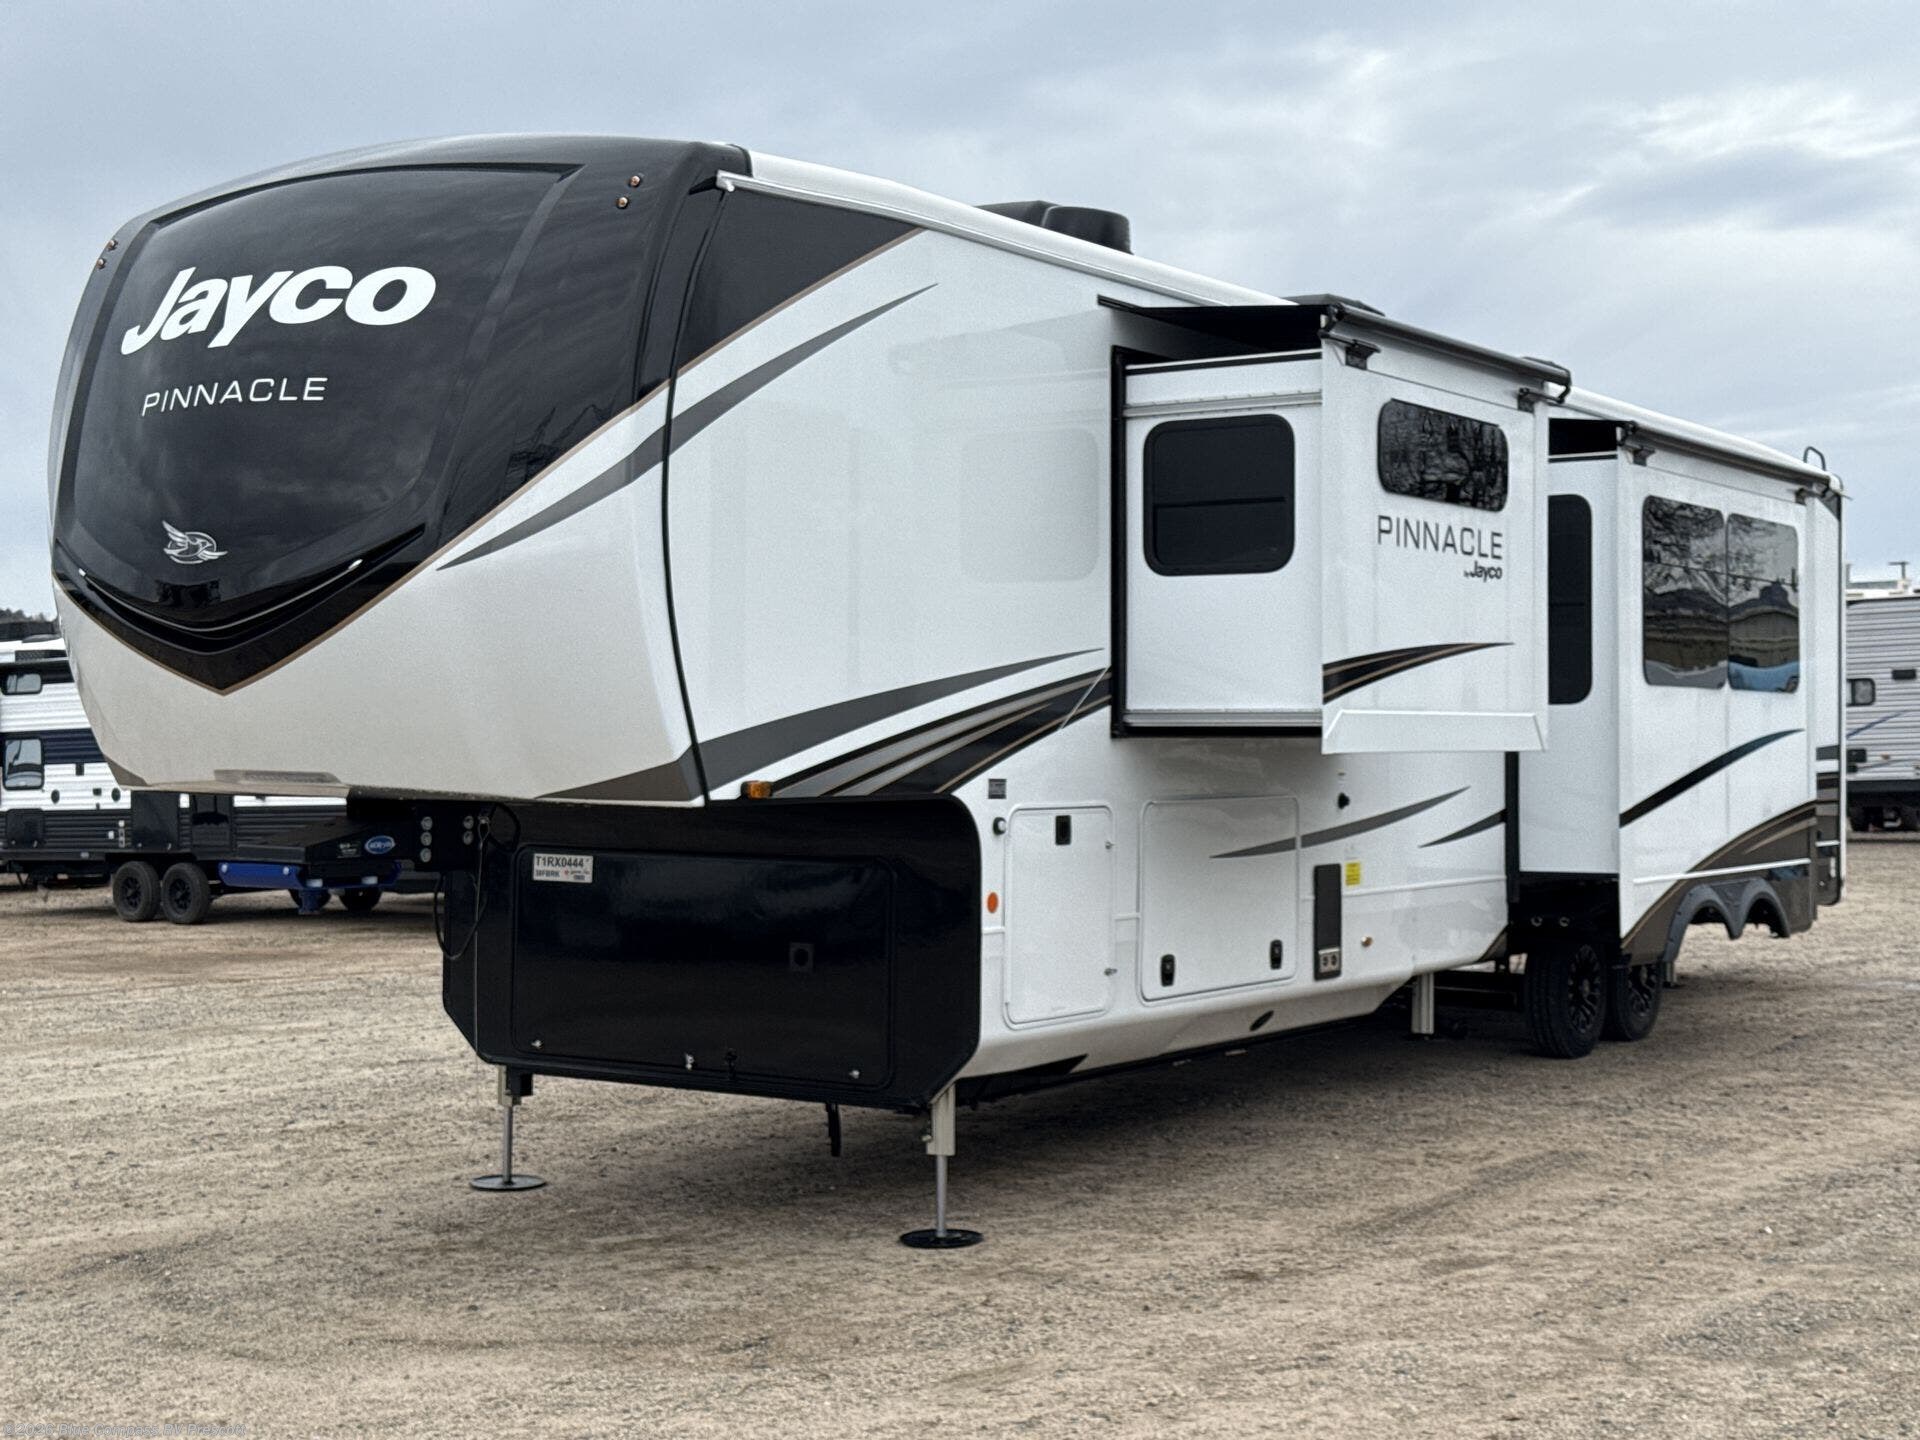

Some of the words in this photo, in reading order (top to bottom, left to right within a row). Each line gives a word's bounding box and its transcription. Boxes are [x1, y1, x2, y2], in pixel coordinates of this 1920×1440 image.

[120, 265, 437, 356] Jayco
[141, 376, 328, 417] PINNACLE
[1377, 514, 1503, 560] PINNACLE
[1470, 561, 1503, 583] Jayco
[535, 855, 584, 868] T1RX0444
